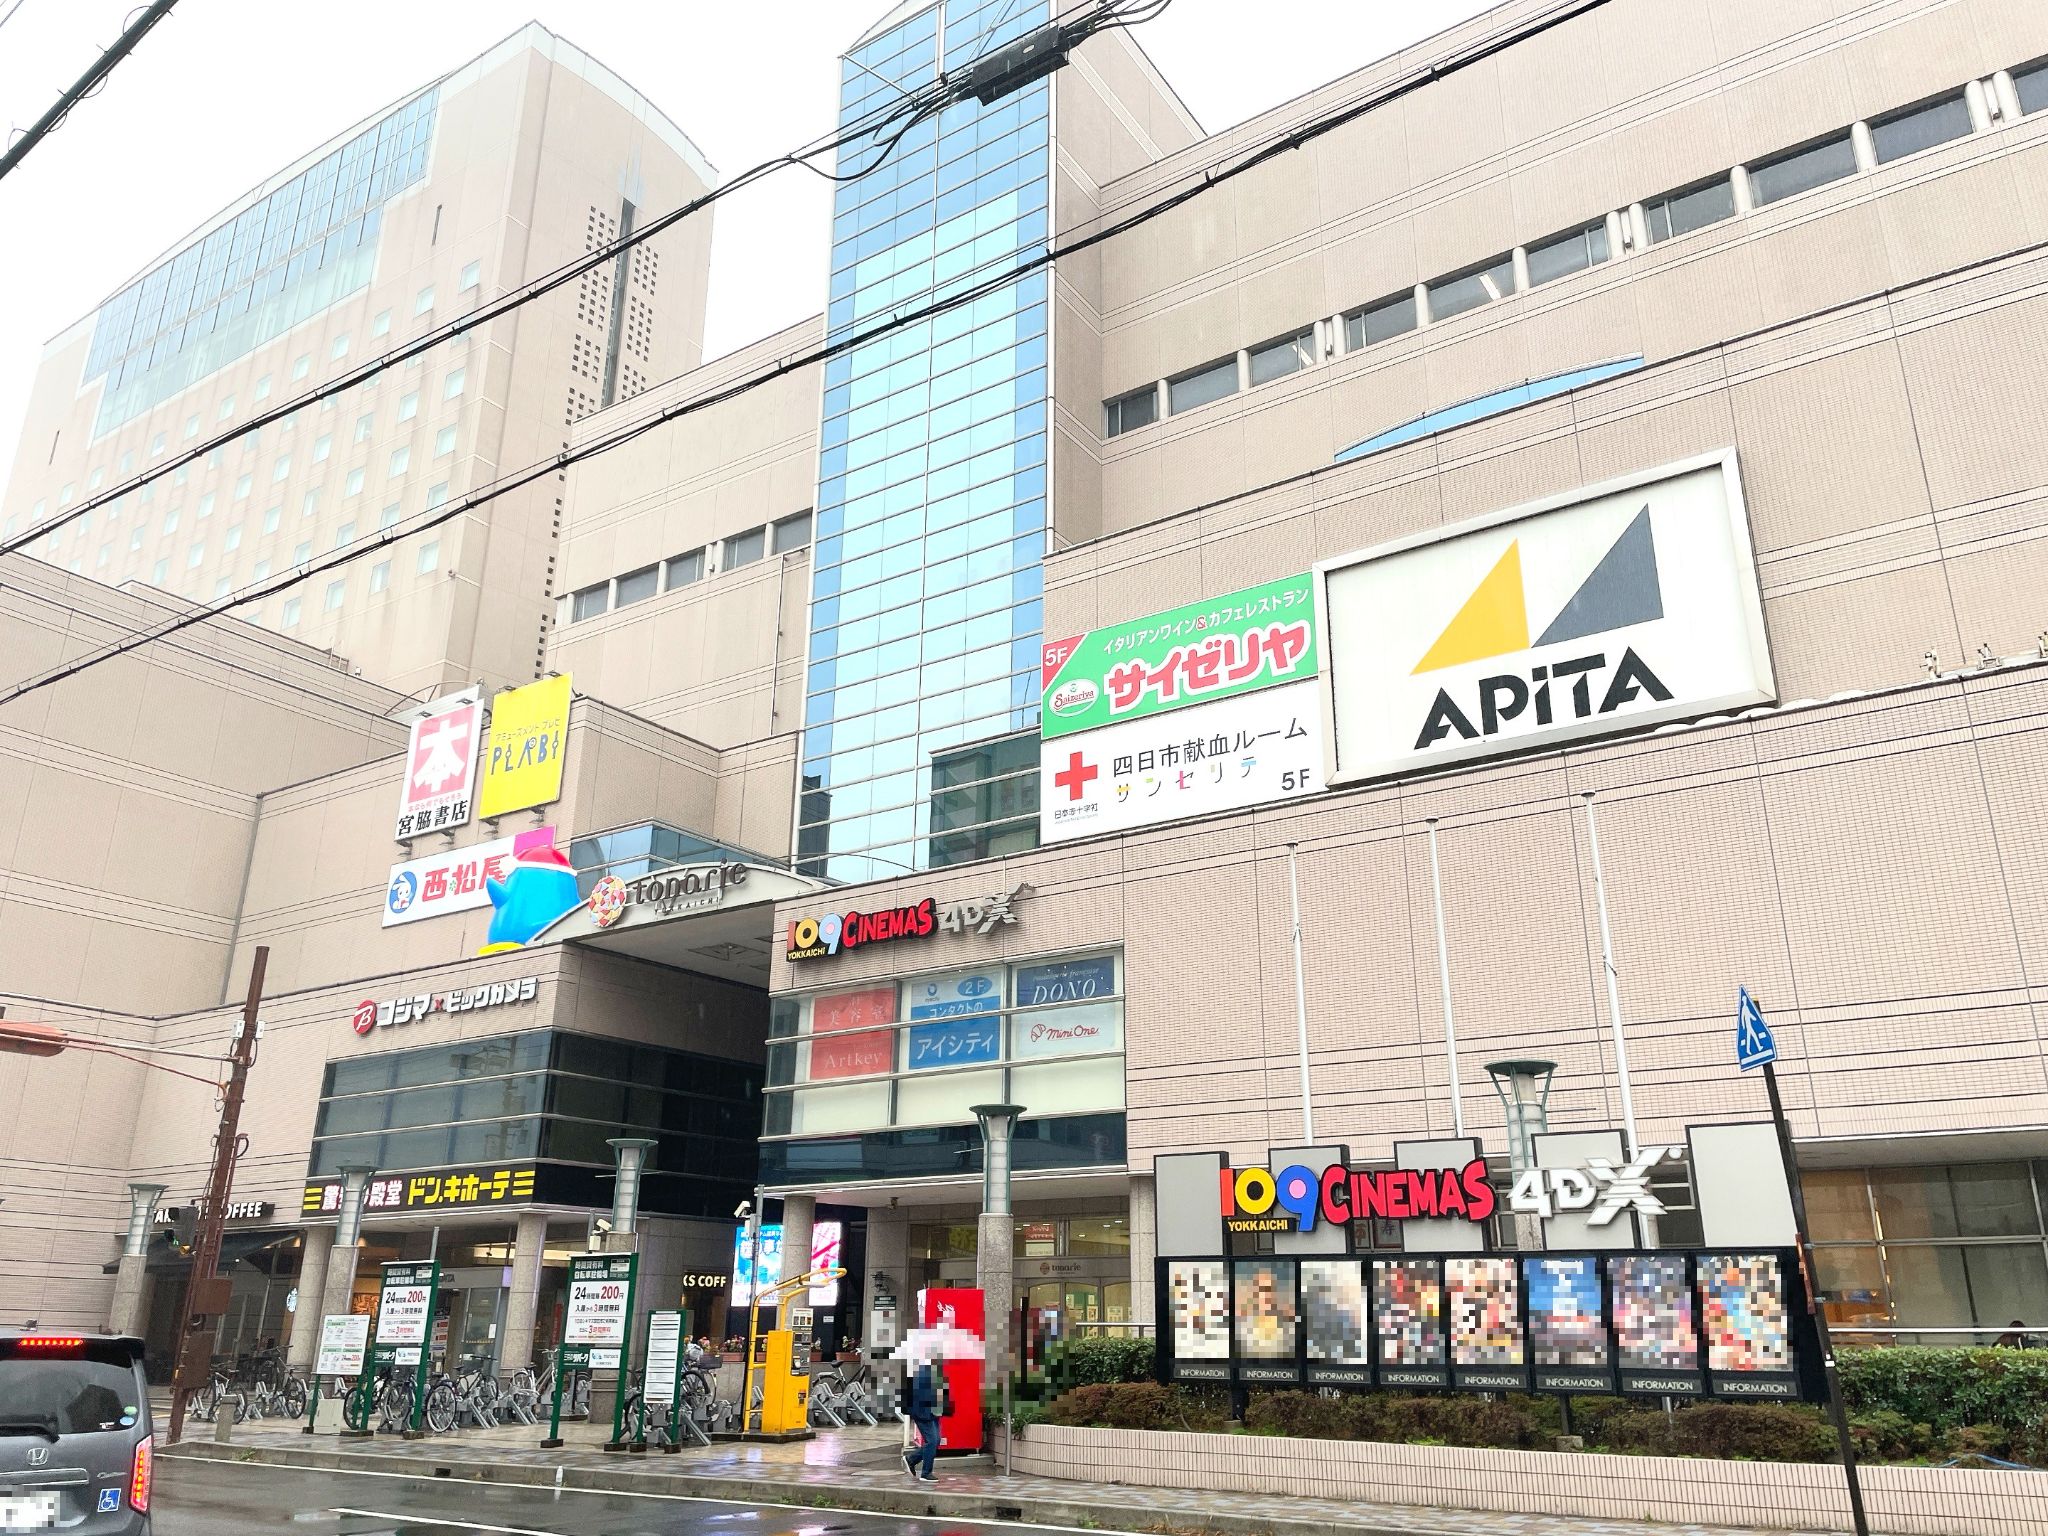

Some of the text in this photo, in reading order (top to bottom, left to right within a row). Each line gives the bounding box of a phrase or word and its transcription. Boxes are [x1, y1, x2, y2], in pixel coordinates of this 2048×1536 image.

[1104, 589, 1309, 655] イタリアンワイン&カフェレストラン
[1045, 646, 1068, 667] 5F
[1107, 624, 1306, 710] サイゼリヤ
[413, 718, 468, 793] 本
[1113, 717, 1308, 778] 四日市献血ルーム
[1281, 768, 1311, 791] 5F
[398, 800, 468, 836] 宮脇書店
[633, 857, 747, 905] tonarie
[786, 912, 843, 954] 109
[842, 899, 934, 948] CINEMAS
[787, 946, 826, 961] YOKKAICHI
[965, 981, 985, 995] 2F
[1031, 979, 1096, 1005] DONO
[930, 1002, 983, 1018] コンタクトの
[917, 1033, 994, 1060] アイシティ
[1220, 1146, 1680, 1232] 109 CINEMAS 4DX
[1227, 1220, 1289, 1232] YOKKAICHI
[1180, 1369, 1225, 1377] INFORMATION
[1246, 1370, 1293, 1379] INFORMATION
[1315, 1372, 1364, 1381] INFORMATION
[1387, 1373, 1440, 1383] INFORMATION
[1465, 1375, 1520, 1386] INFORMATION
[1546, 1377, 1604, 1388] INFORMATION
[1632, 1380, 1694, 1391] INFORMATION
[1723, 1382, 1788, 1394] INFORMATION
